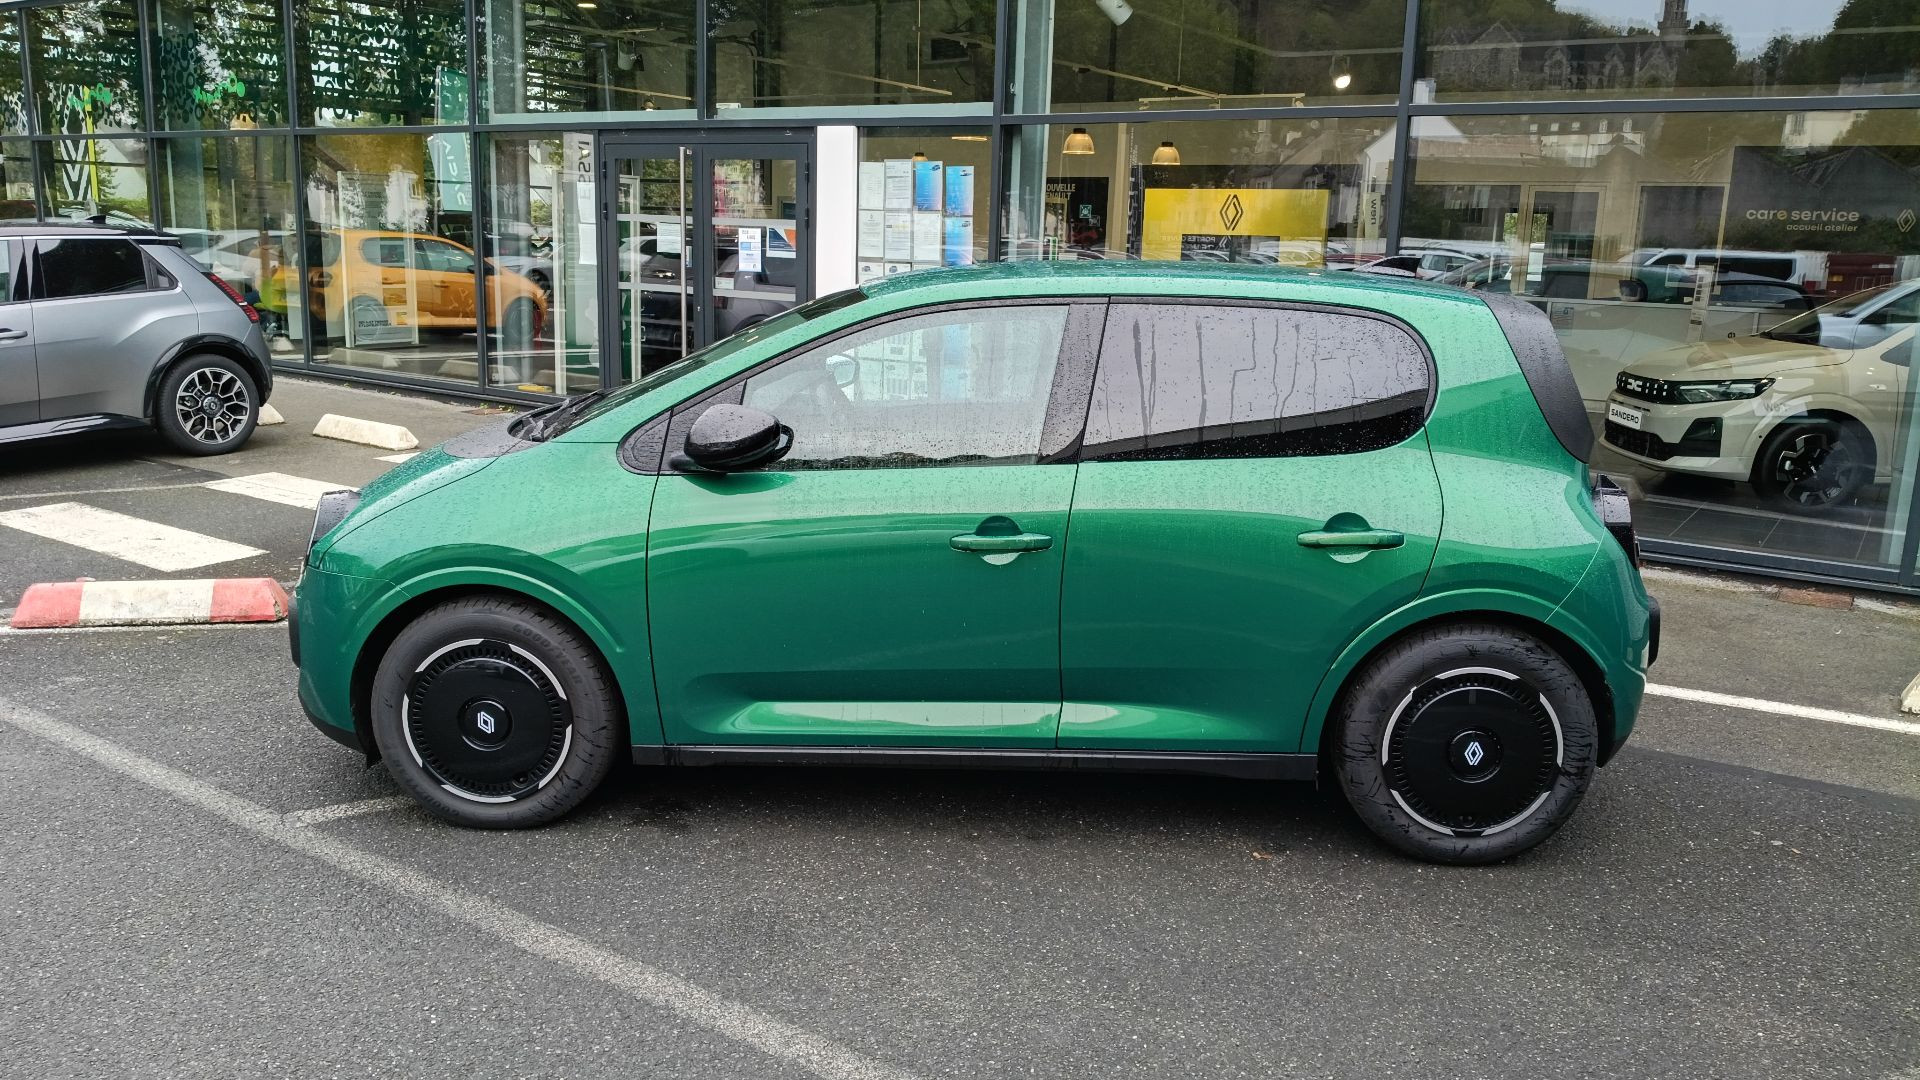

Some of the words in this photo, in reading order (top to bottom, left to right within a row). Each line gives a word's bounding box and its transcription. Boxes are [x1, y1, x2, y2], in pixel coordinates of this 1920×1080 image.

[1046, 183, 1076, 192] OUVELLE
[1045, 192, 1072, 201] ENAULT
[1745, 209, 1788, 221] care
[1791, 208, 1860, 222] service
[1786, 223, 1823, 232] accueil
[1824, 224, 1858, 232] atelier
[1610, 408, 1640, 424] SANDERO
